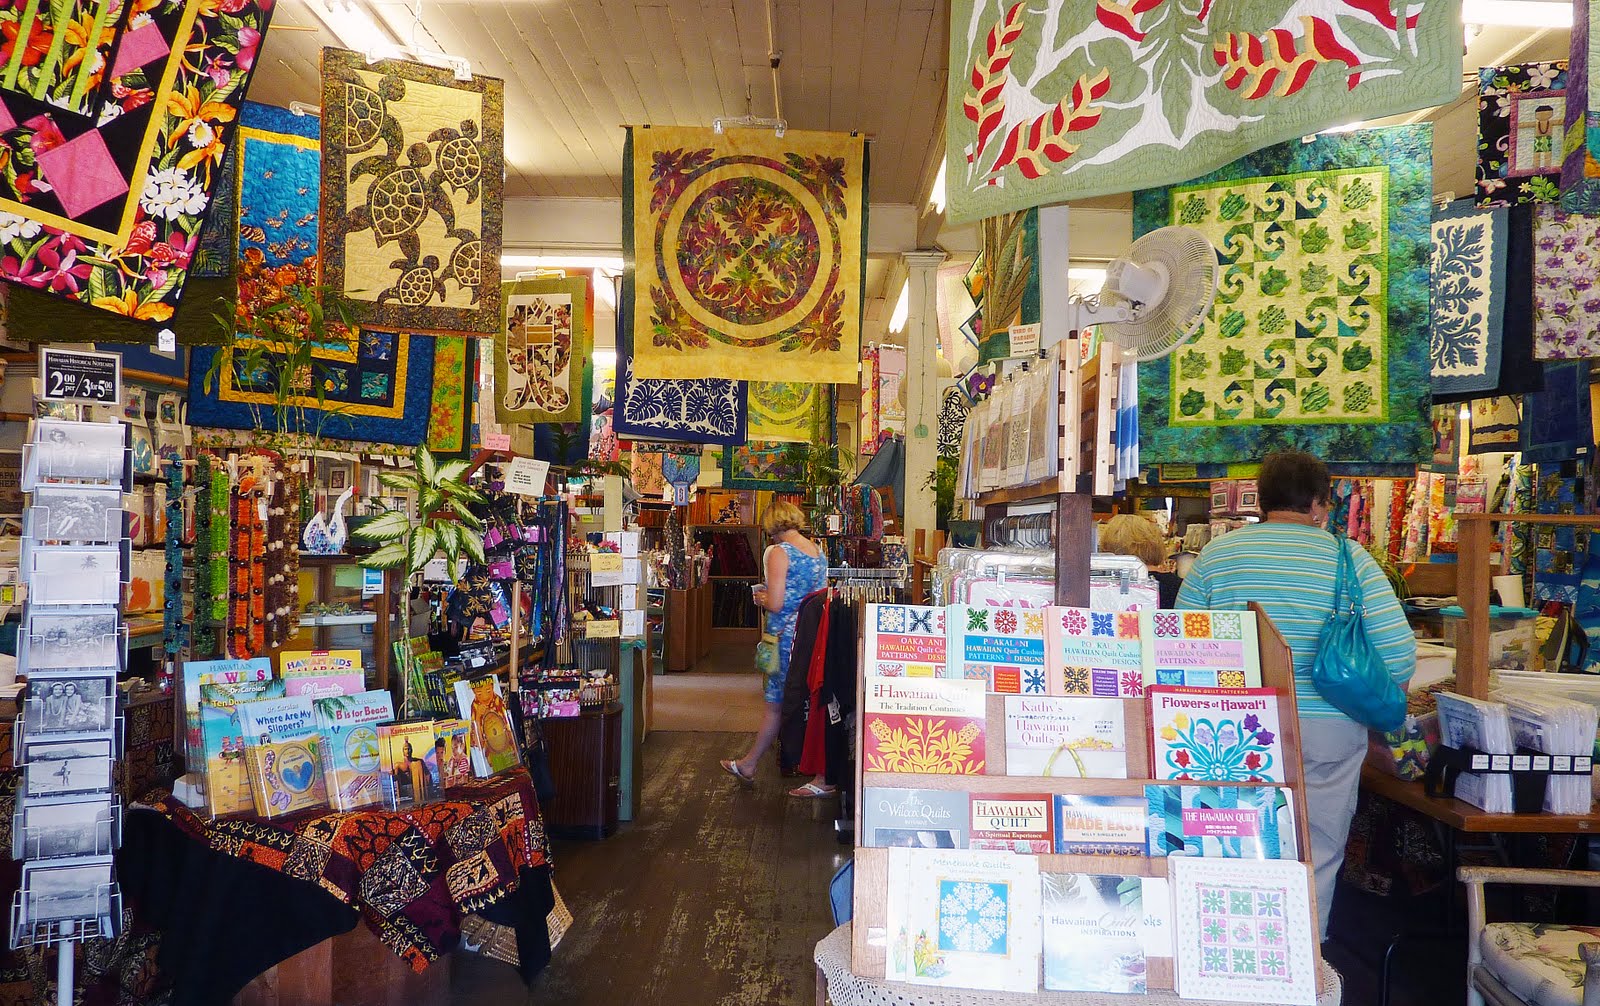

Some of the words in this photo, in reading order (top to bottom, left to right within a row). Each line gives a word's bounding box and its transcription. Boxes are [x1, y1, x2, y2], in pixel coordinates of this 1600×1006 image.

[90, 382, 98, 390] for
[897, 637, 943, 646] OAKAANI
[1081, 640, 1126, 650] POKALNI
[880, 644, 916, 652] HAWAIIAN
[916, 646, 933, 654] Quilt
[966, 645, 1002, 653] HAWAIIAN
[1004, 648, 1020, 656] Quilt
[1064, 648, 1100, 656] HAWAIIAN
[881, 652, 918, 660] PATTERNS
[968, 652, 1004, 660] PATTERNS
[200, 670, 266, 684] FLOWES
[241, 686, 266, 694] Carolan
[880, 684, 938, 700] Hawaiian
[880, 702, 894, 710] The
[895, 702, 928, 712] Tradition
[930, 704, 967, 712] Continues
[1022, 700, 1063, 713] Kathy's
[1162, 696, 1210, 709] Flowers
[256, 716, 283, 726] Where
[284, 712, 298, 721] Are
[300, 710, 312, 718] My
[336, 710, 342, 720] B
[352, 709, 363, 718] for
[364, 705, 388, 716] Beach
[268, 720, 304, 734] Slippers?
[390, 724, 430, 736] Kamehameha
[1016, 719, 1070, 732] Hawaiian
[1022, 732, 1054, 746] Quilts
[879, 800, 919, 818] Wilcox
[920, 804, 951, 824] Quilts
[977, 806, 1043, 816] HAWAIIAN
[990, 818, 1030, 830] QUILT
[1184, 812, 1198, 822] THE
[1200, 812, 1234, 822] HAWAIIAN
[1235, 812, 1256, 824] QUILT
[1066, 818, 1103, 831] MADE
[1051, 915, 1098, 927] Hawaiian
[1080, 928, 1136, 938] INSPIRATIONS
